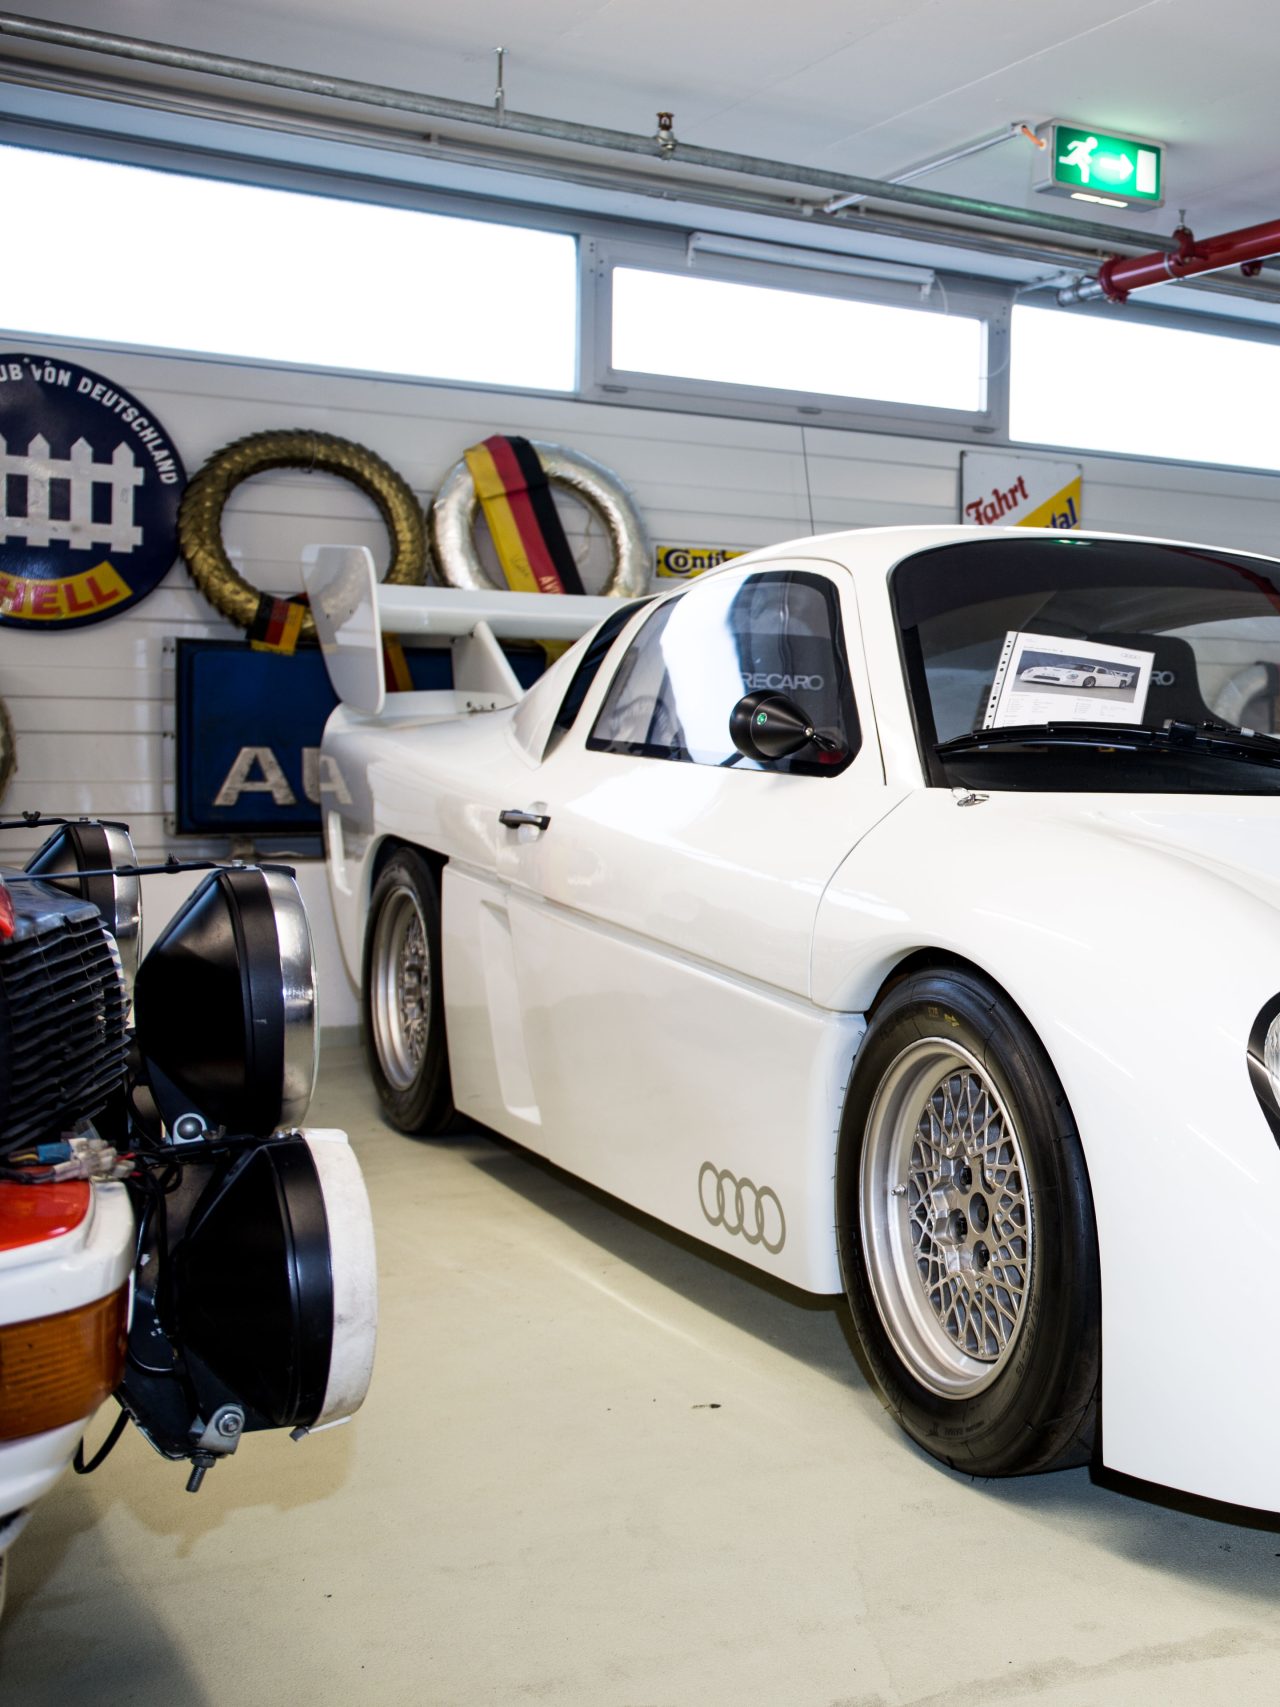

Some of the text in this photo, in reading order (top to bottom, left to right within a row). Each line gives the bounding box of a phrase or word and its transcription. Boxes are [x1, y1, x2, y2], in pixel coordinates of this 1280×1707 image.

[30, 363, 72, 388] VON
[77, 375, 179, 485] DEUTSCHLAND
[1045, 496, 1078, 529] tal
[740, 672, 825, 691] RECARO
